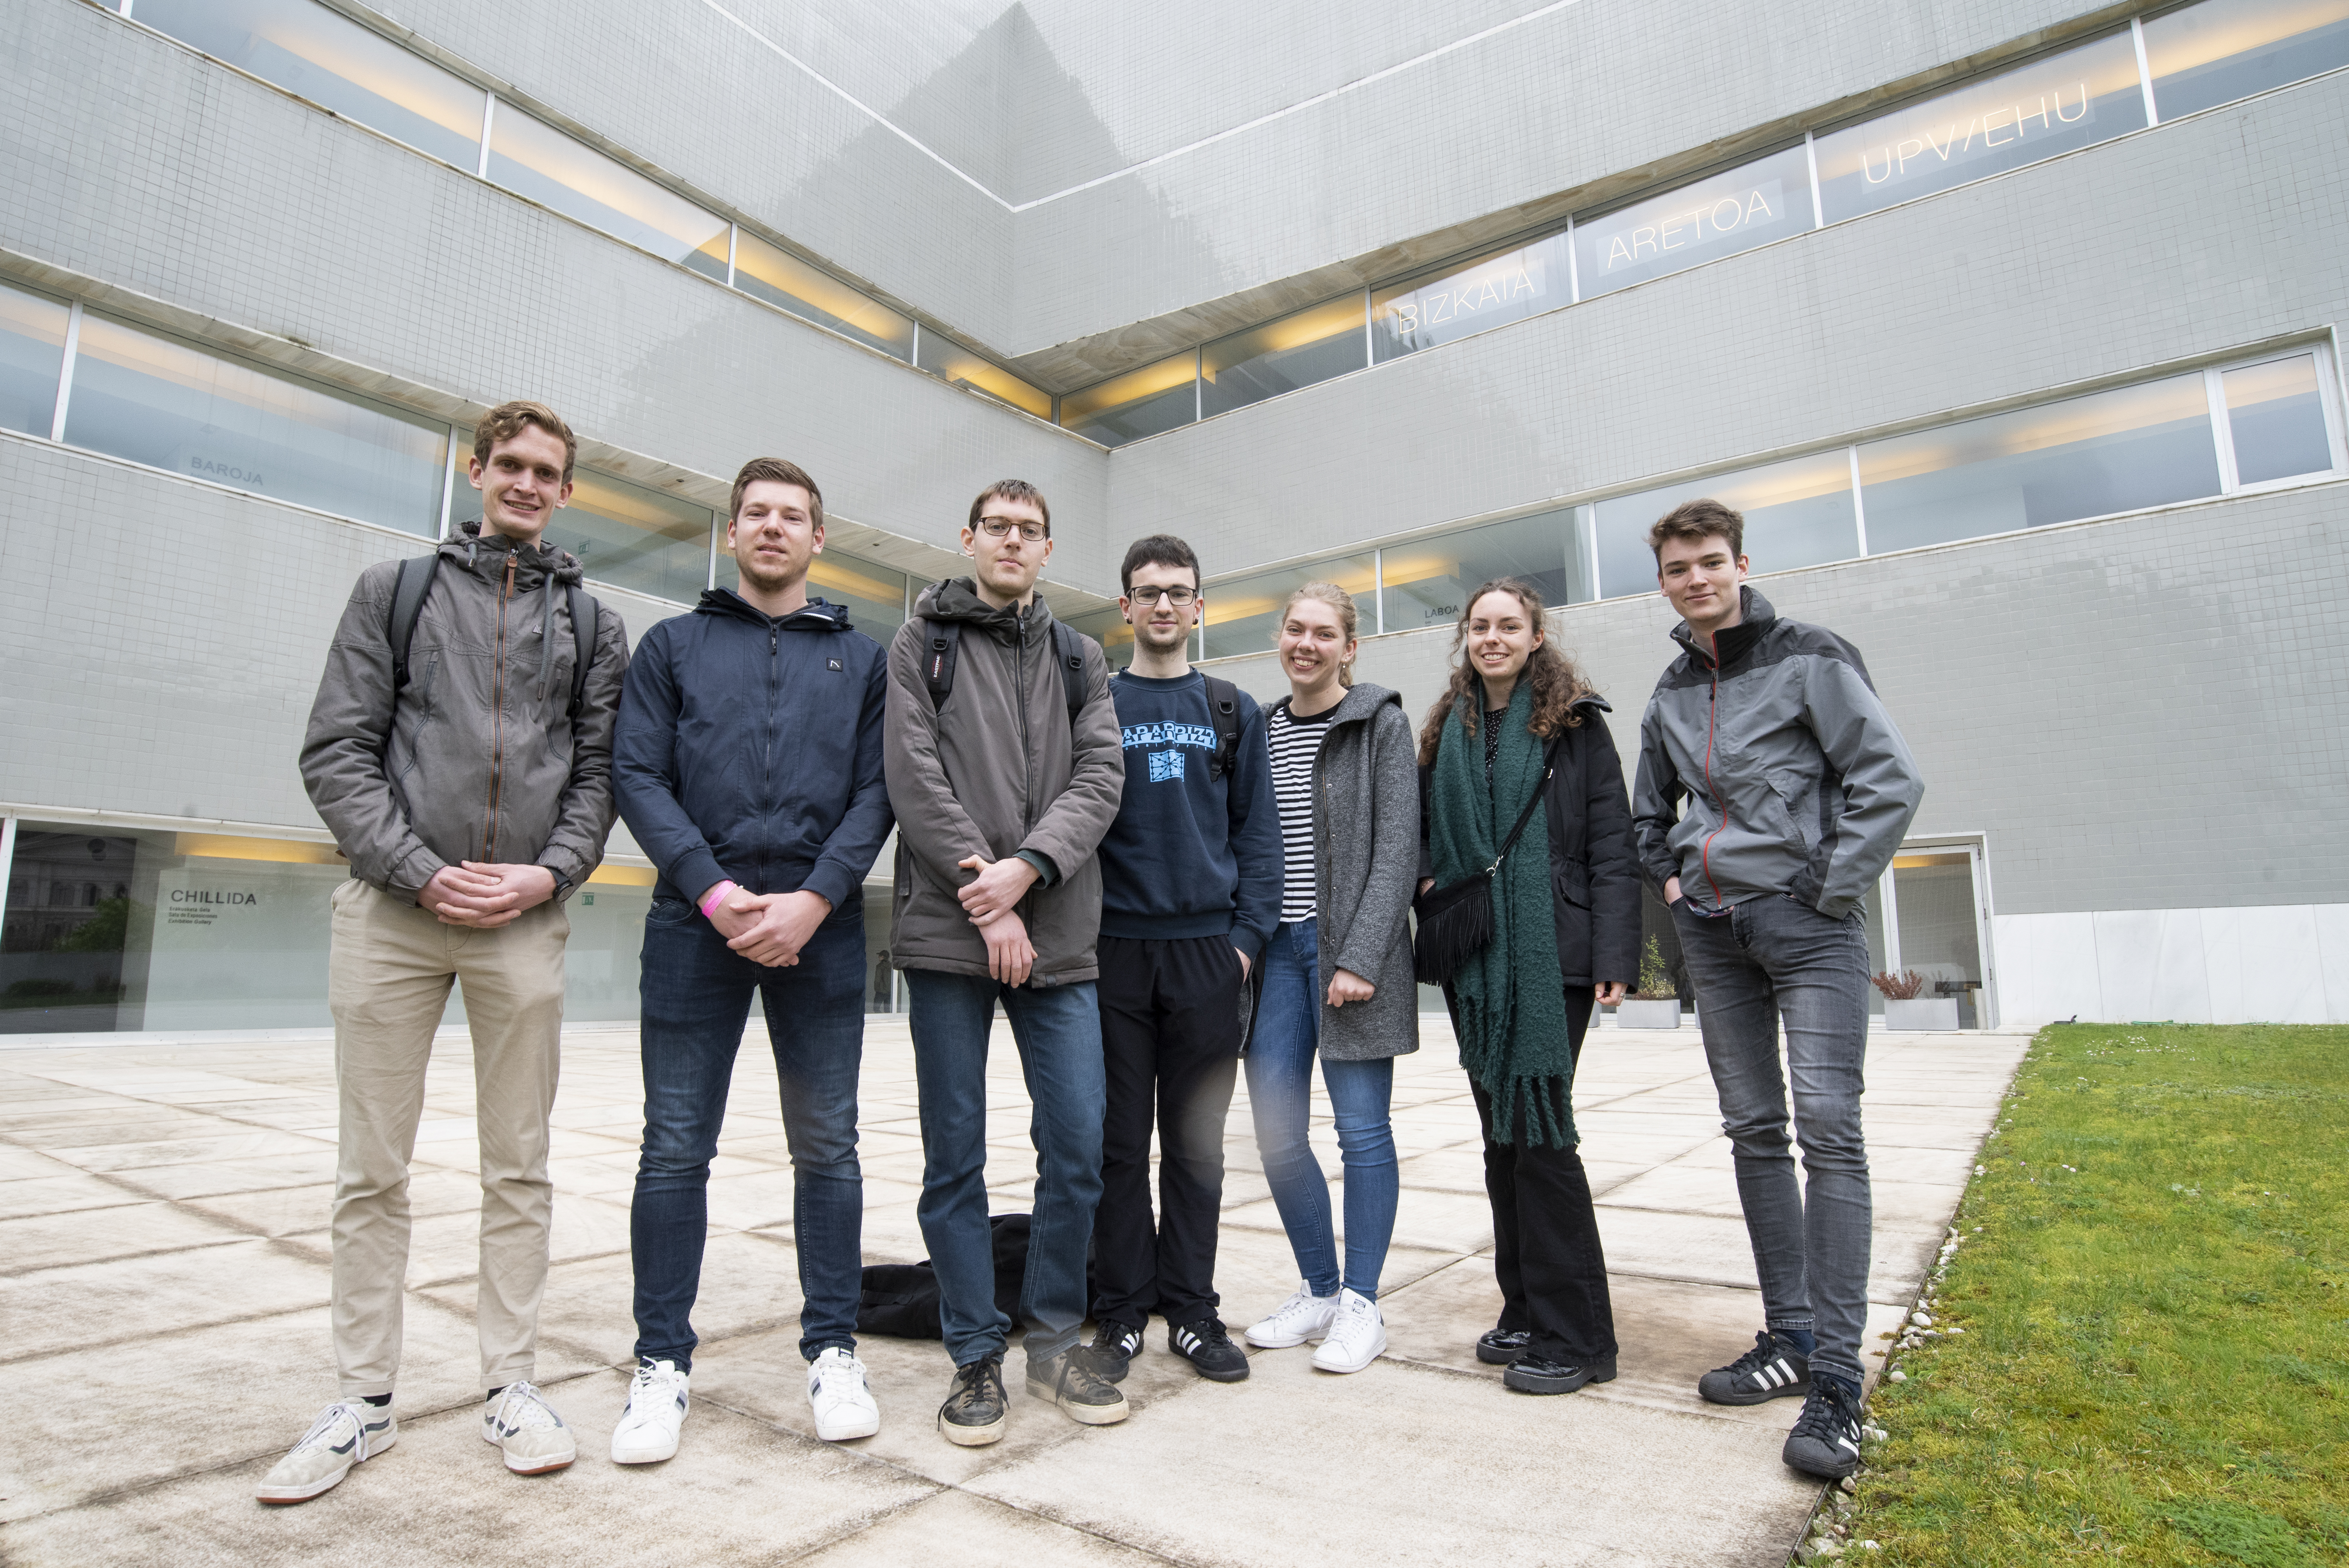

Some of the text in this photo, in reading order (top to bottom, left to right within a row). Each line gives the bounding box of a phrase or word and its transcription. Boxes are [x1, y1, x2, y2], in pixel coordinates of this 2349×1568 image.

[1398, 83, 2087, 334] BIZKAIA ARETOA UPV/EHU
[192, 456, 263, 486] BAROJA
[1425, 605, 1459, 618] LABOA
[171, 889, 257, 905] CHILLIDA
